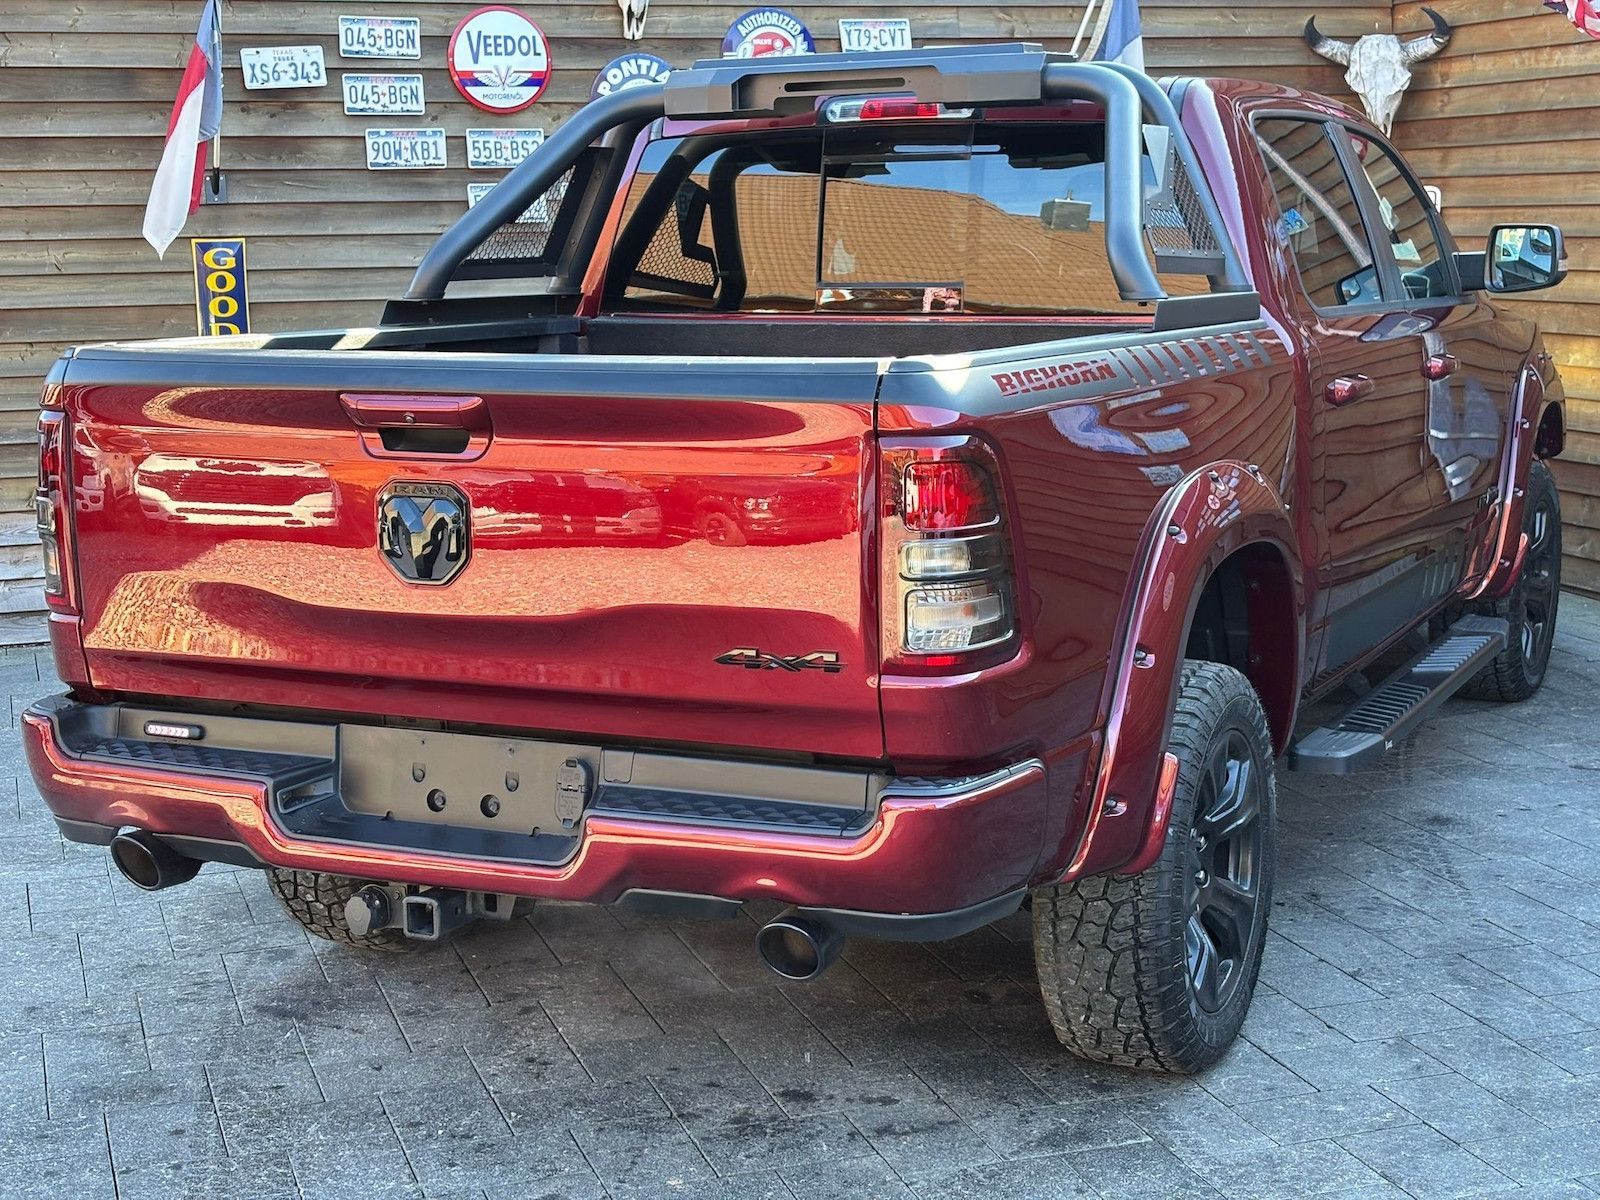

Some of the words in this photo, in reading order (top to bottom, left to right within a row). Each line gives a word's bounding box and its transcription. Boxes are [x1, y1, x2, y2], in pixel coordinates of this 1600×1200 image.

[737, 12, 802, 37] AUTHORIZED
[466, 30, 541, 64] VEEDOL
[990, 357, 1118, 397] BIGHORN
[393, 484, 450, 498] RAM
